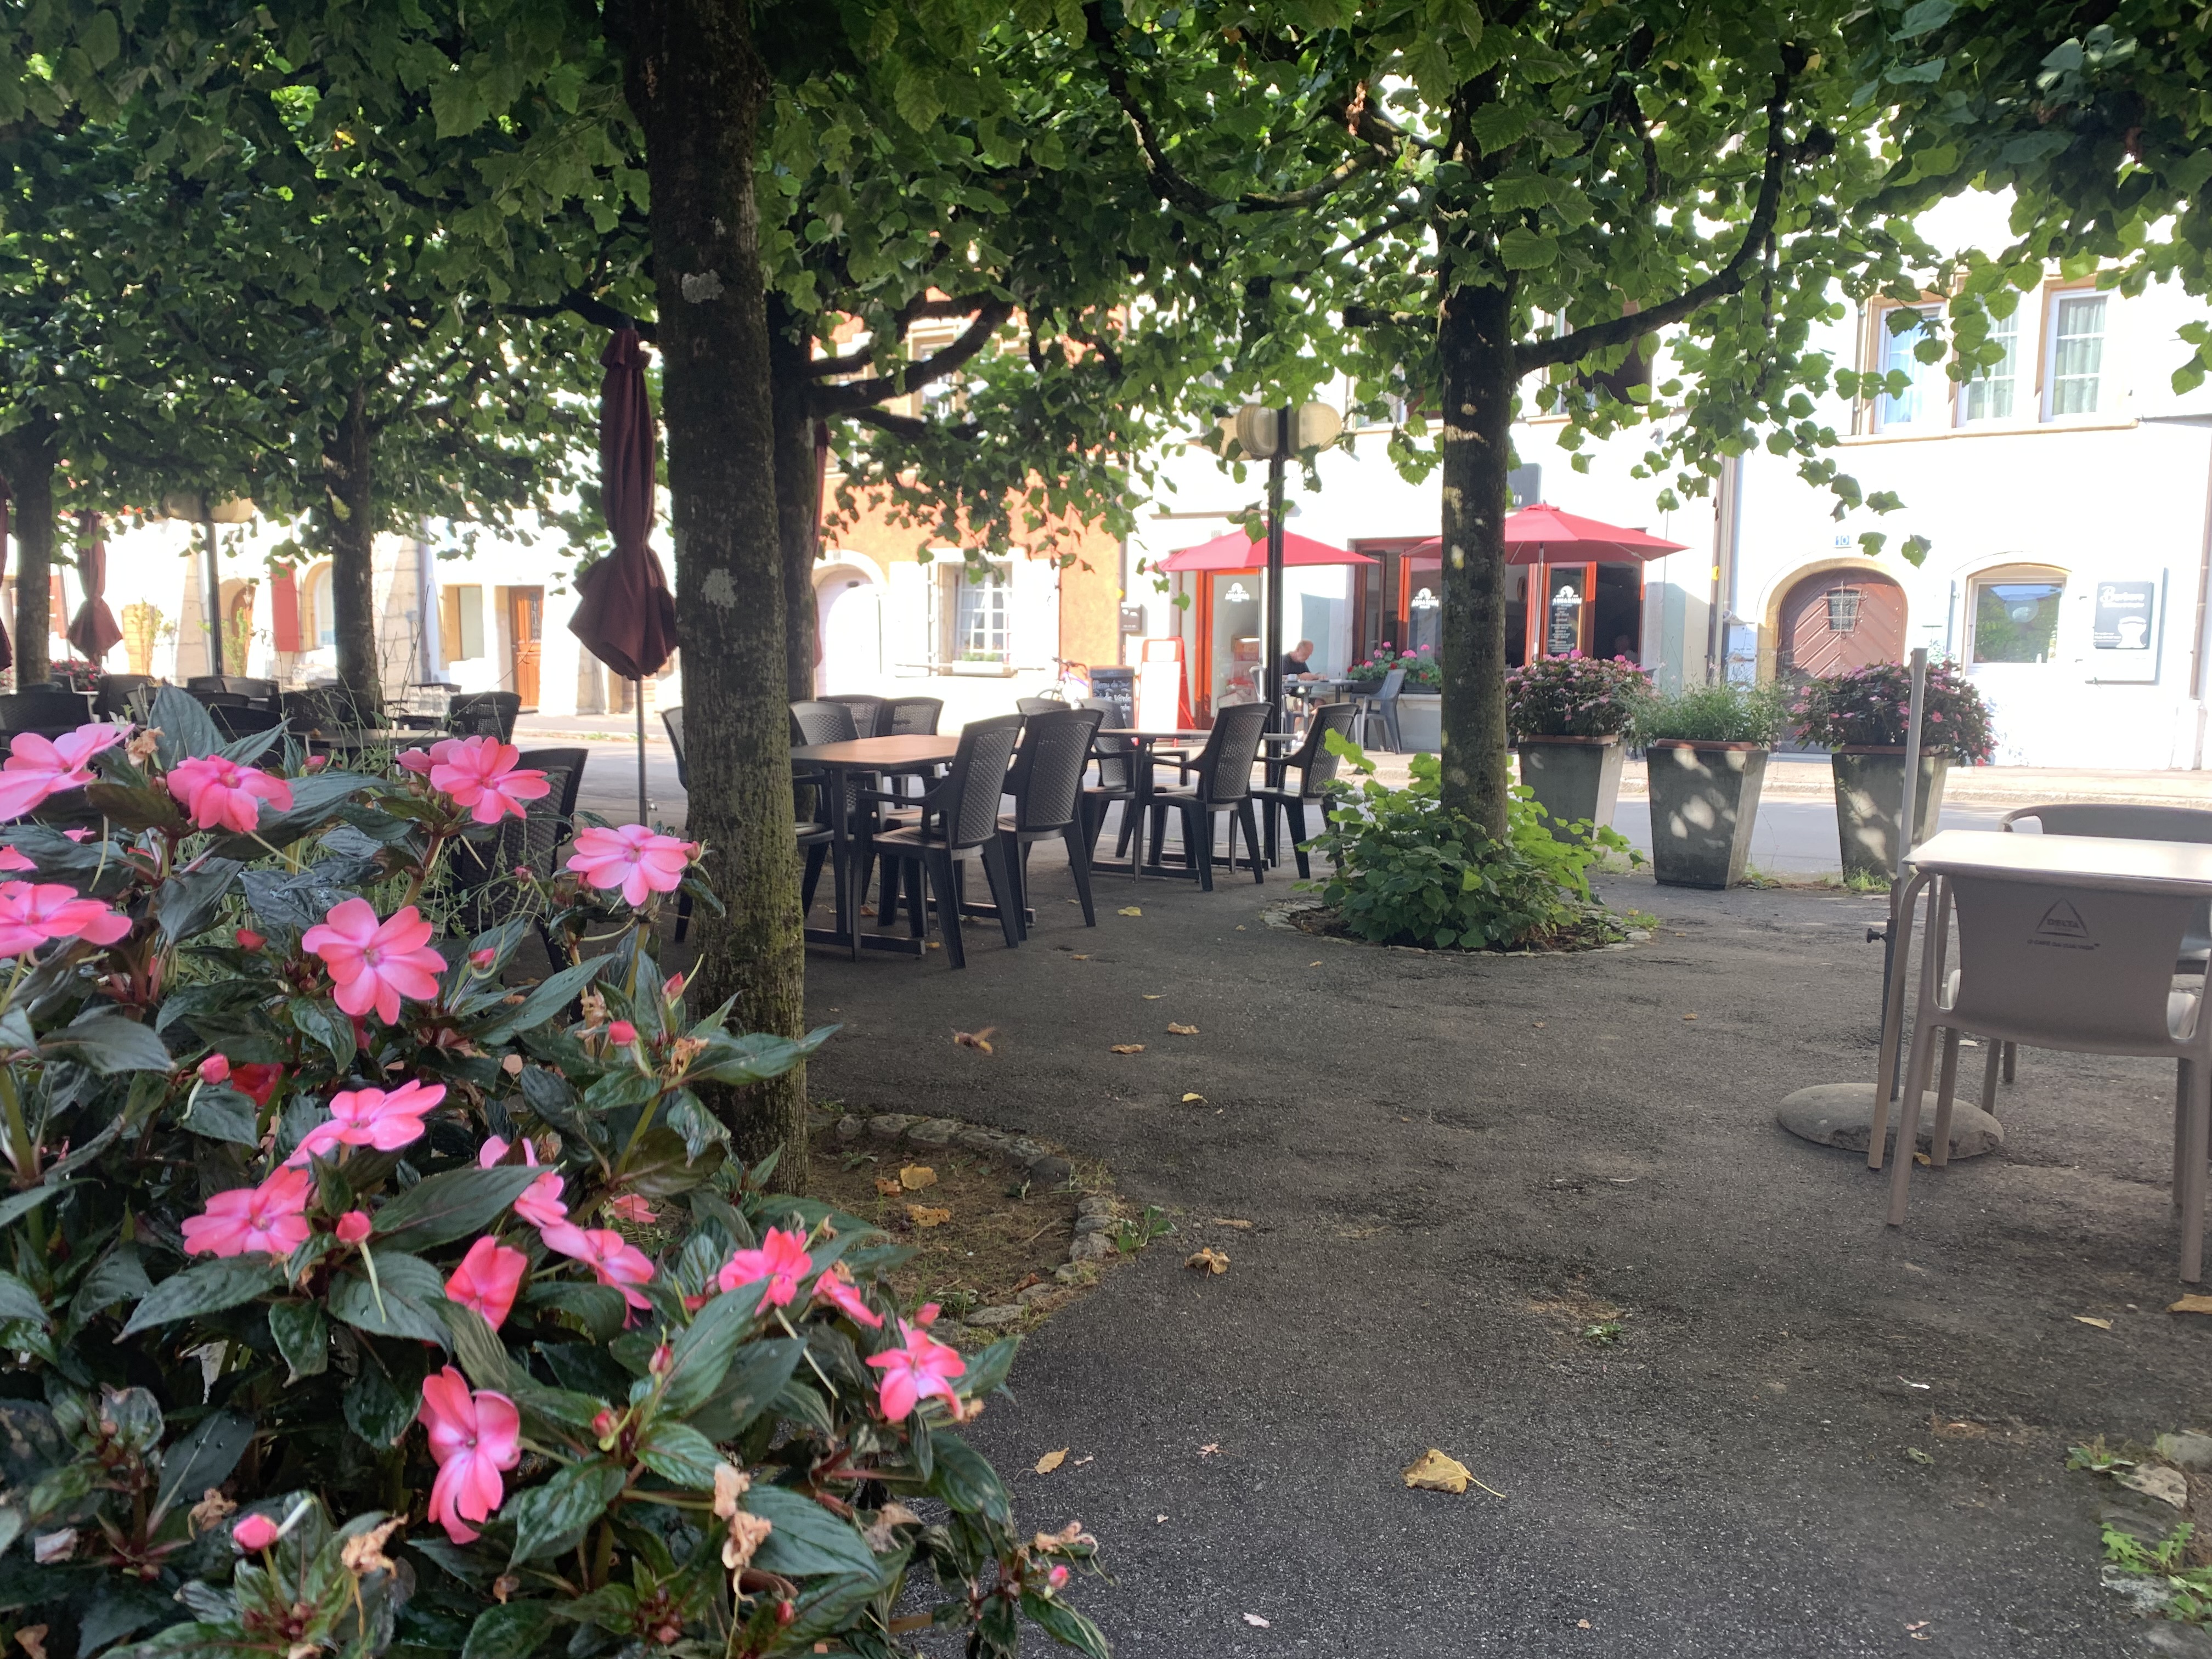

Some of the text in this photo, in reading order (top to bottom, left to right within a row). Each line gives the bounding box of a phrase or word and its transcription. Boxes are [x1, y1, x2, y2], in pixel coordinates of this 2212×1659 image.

[1838, 535, 1848, 545] 10
[1093, 680, 1110, 689] Menu
[2047, 918, 2079, 928] DELTA
